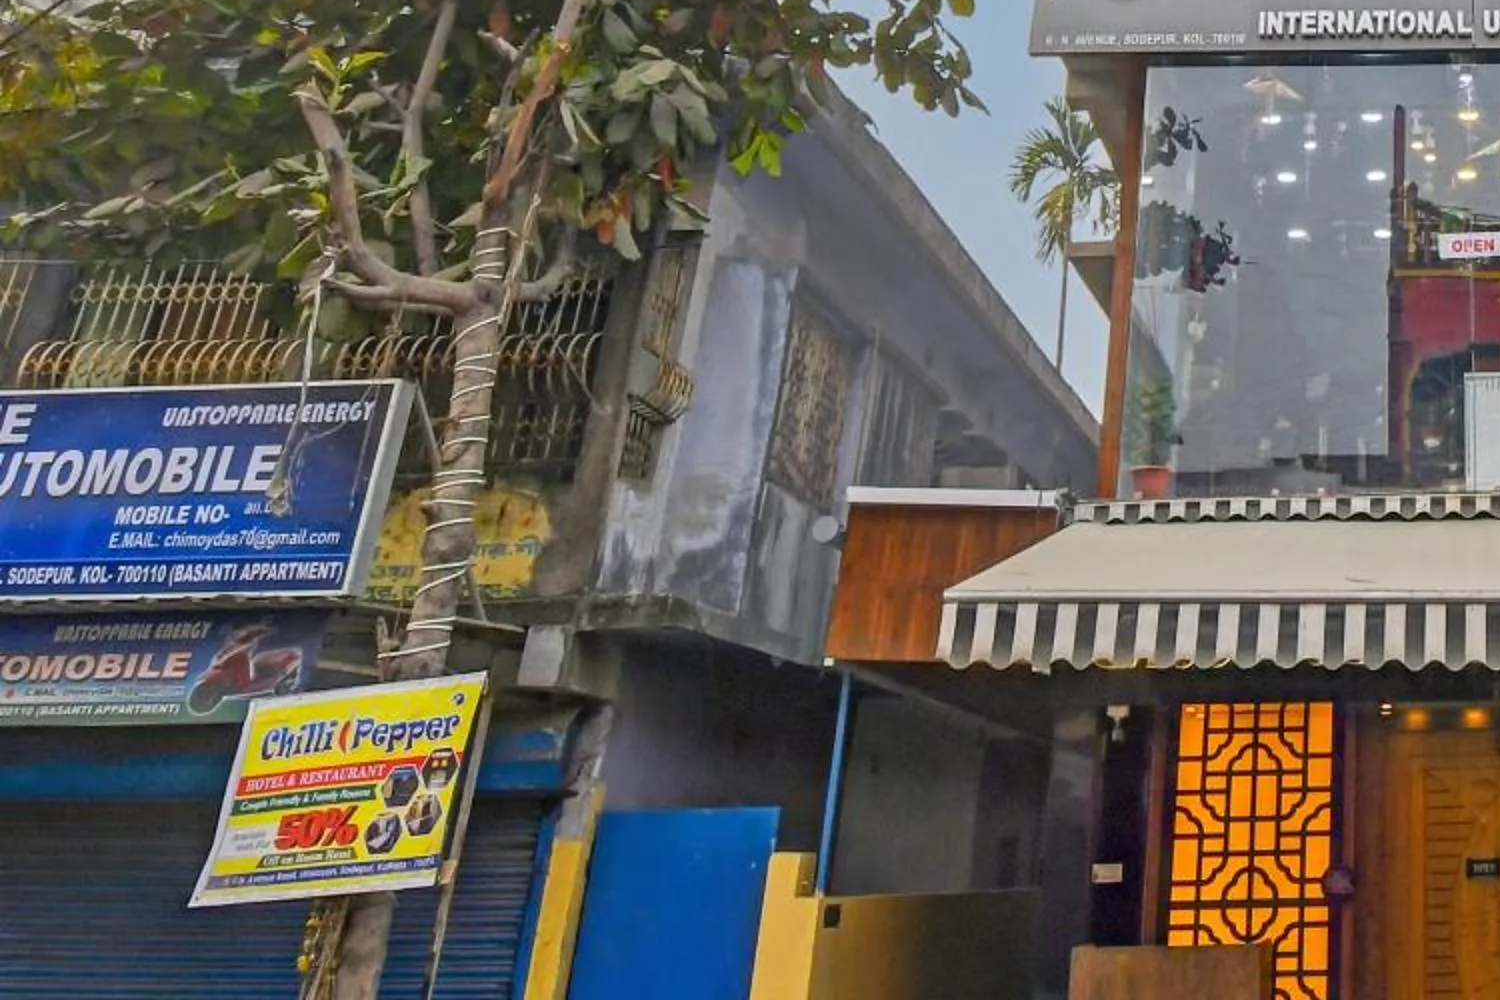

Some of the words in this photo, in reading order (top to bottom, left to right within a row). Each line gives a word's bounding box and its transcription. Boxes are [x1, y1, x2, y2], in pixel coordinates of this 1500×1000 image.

[1257, 9, 1472, 39] INTERNATIONAL
[1452, 240, 1495, 252] OPEN
[0, 403, 37, 446] E
[300, 402, 374, 423] ENERGY
[115, 505, 190, 526] MOBILE
[194, 503, 231, 524] NO-
[117, 563, 166, 583] 700110
[169, 562, 238, 587] (BASANTI
[239, 560, 344, 583] APPARTMENT)
[0, 651, 192, 681] OMOBILE
[261, 720, 338, 761] Chilli
[352, 714, 460, 751] Pepper
[245, 776, 285, 793] HOTEL
[299, 764, 387, 785] RESTAURANT
[275, 805, 360, 851] 50%
